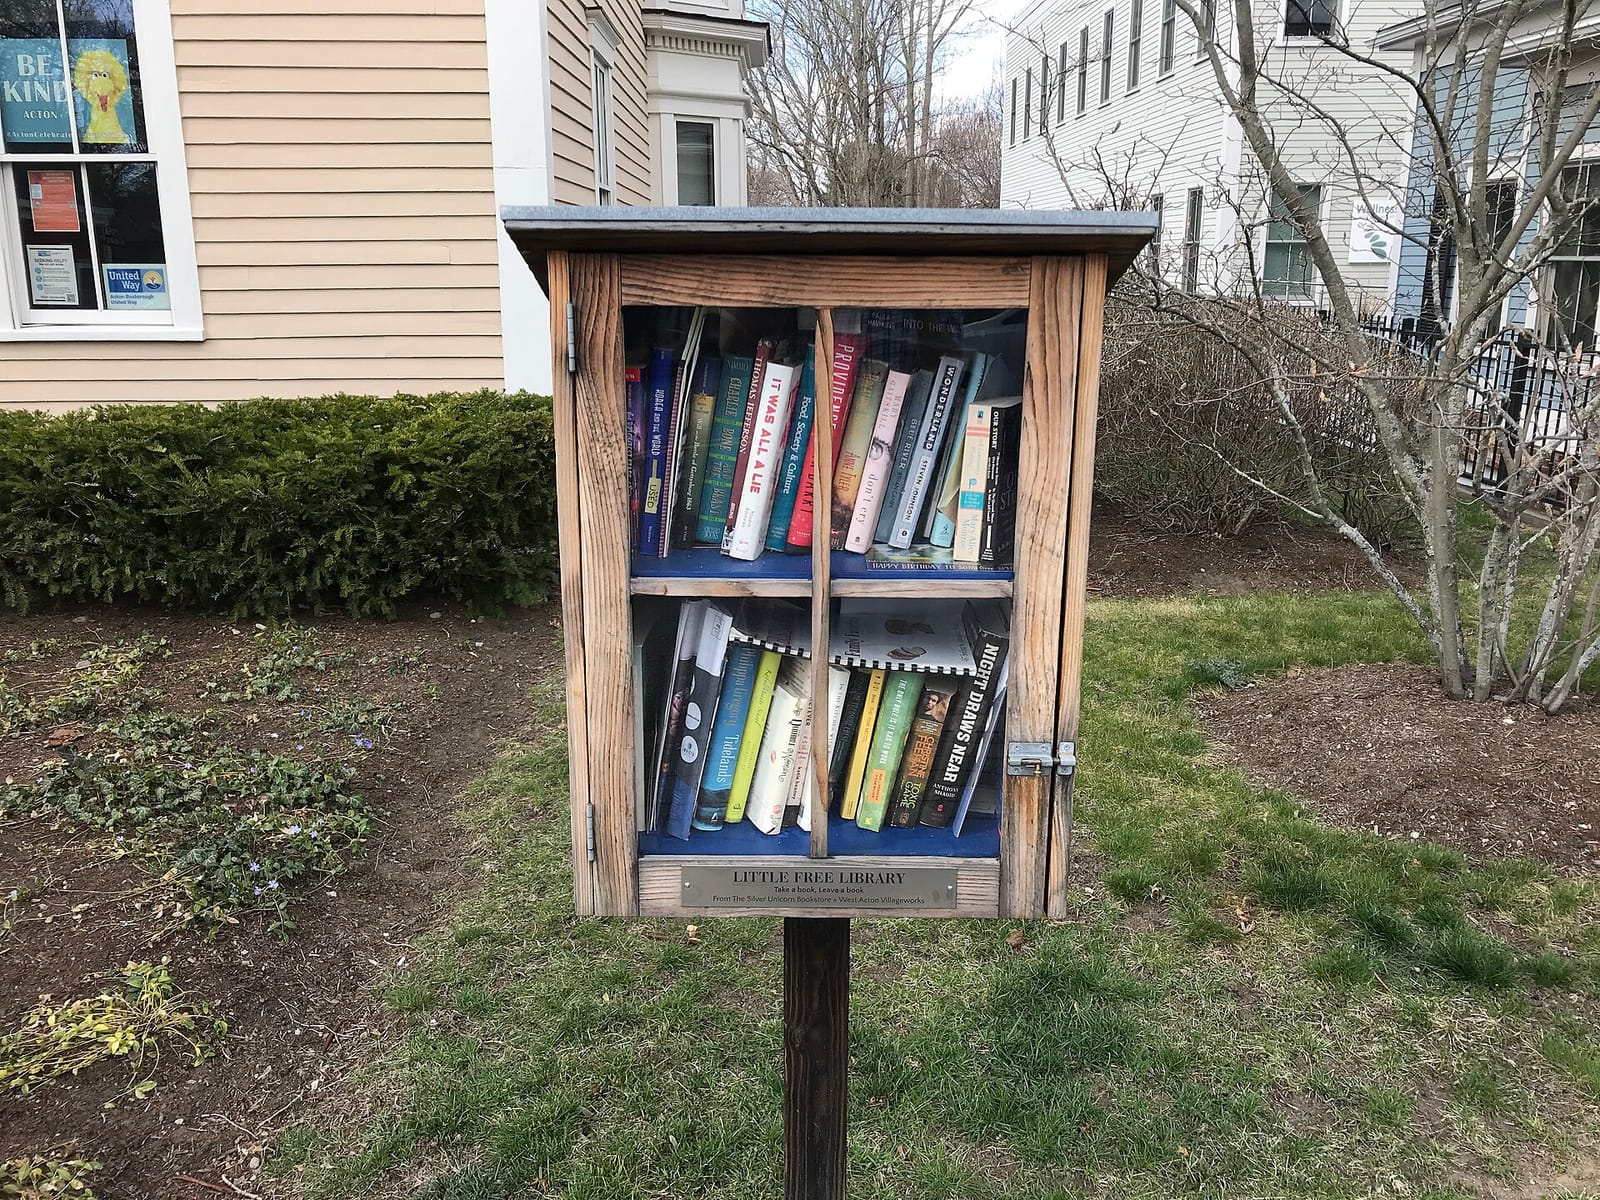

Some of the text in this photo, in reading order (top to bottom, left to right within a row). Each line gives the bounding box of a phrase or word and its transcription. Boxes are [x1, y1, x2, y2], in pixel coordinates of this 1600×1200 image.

[16, 54, 53, 77] BE
[3, 80, 67, 104] KIND
[24, 110, 58, 119] ACTON
[1356, 203, 1398, 214] Wllness
[108, 270, 140, 280] United
[122, 280, 140, 292] Way
[903, 318, 924, 330] INTO
[928, 322, 944, 332] THE
[654, 388, 664, 412] KOREA
[725, 378, 742, 417] CHARLIE
[740, 356, 764, 454] THOMAS JEFFERSON
[798, 396, 812, 420] Food,
[890, 395, 902, 418] MARY
[926, 366, 955, 450] WONDERLAND
[651, 434, 662, 456] WORLD
[720, 428, 734, 452] BONE
[750, 378, 782, 494] IT WAS ALL A LIE
[791, 422, 806, 453] Society
[899, 418, 918, 469] BLUE RIVER
[783, 463, 797, 494] Culture
[905, 460, 928, 520] STEVEN JOHNSON
[647, 484, 656, 508] USED
[710, 488, 726, 515] BEAST
[856, 507, 868, 525] cry
[970, 514, 978, 532] Mary
[899, 680, 907, 689] THE
[896, 691, 904, 703] ONLY
[716, 648, 756, 783] Philippa Gregory Tidelands
[944, 643, 999, 783] NIGHT DRAWS NEAR
[908, 735, 927, 777] FEEHAN
[920, 736, 934, 779] CHRISTINE
[900, 781, 913, 808] GAME
[908, 782, 922, 809] TOXIC
[734, 872, 906, 884] LITTLE FREE LIBRARY
